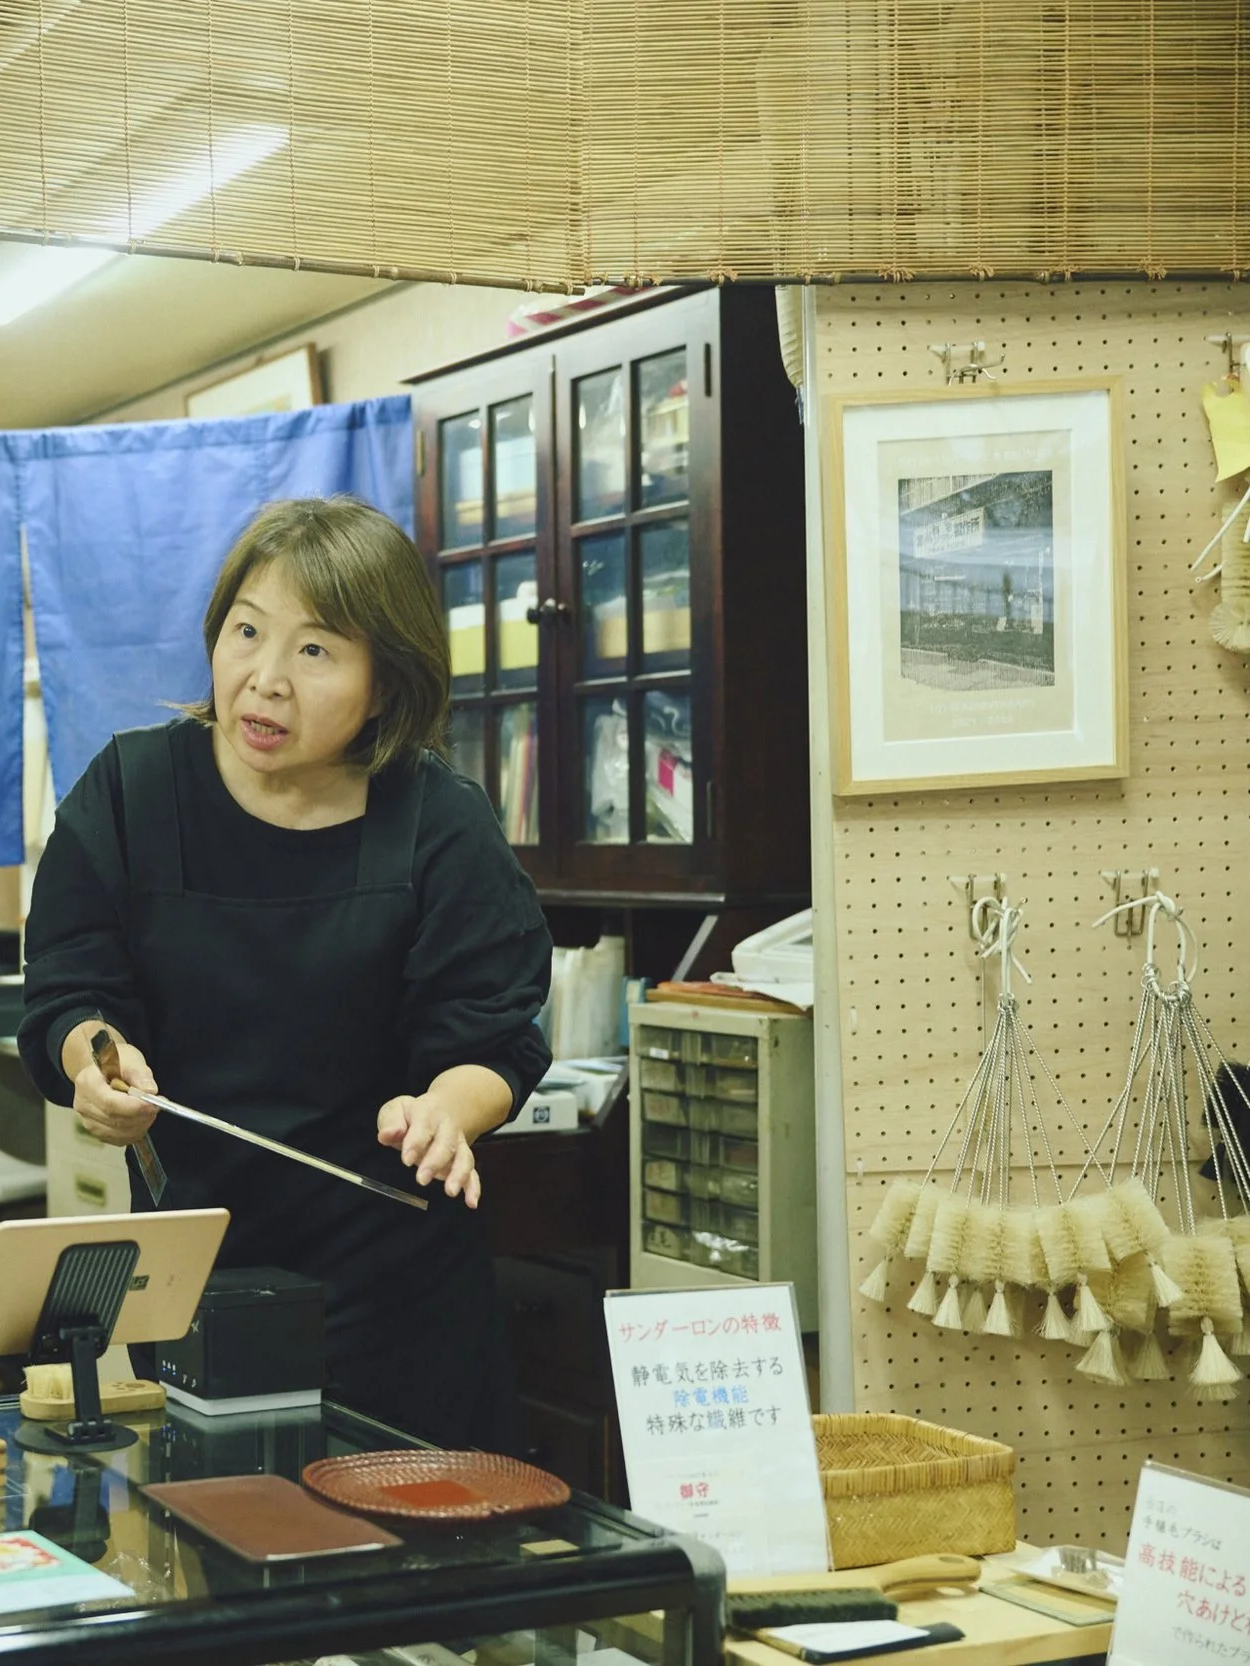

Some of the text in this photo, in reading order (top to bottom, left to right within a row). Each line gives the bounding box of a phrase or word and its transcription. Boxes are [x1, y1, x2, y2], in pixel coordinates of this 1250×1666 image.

[618, 1312, 782, 1343] サンダーロンの特徴
[631, 1356, 783, 1387] 静電気を除去する
[673, 1385, 749, 1408] 除電機能
[646, 1405, 782, 1435] 特殊な繊維です
[1139, 1542, 1247, 1597] 高技能による
[1177, 1590, 1250, 1635] 穴あけと
